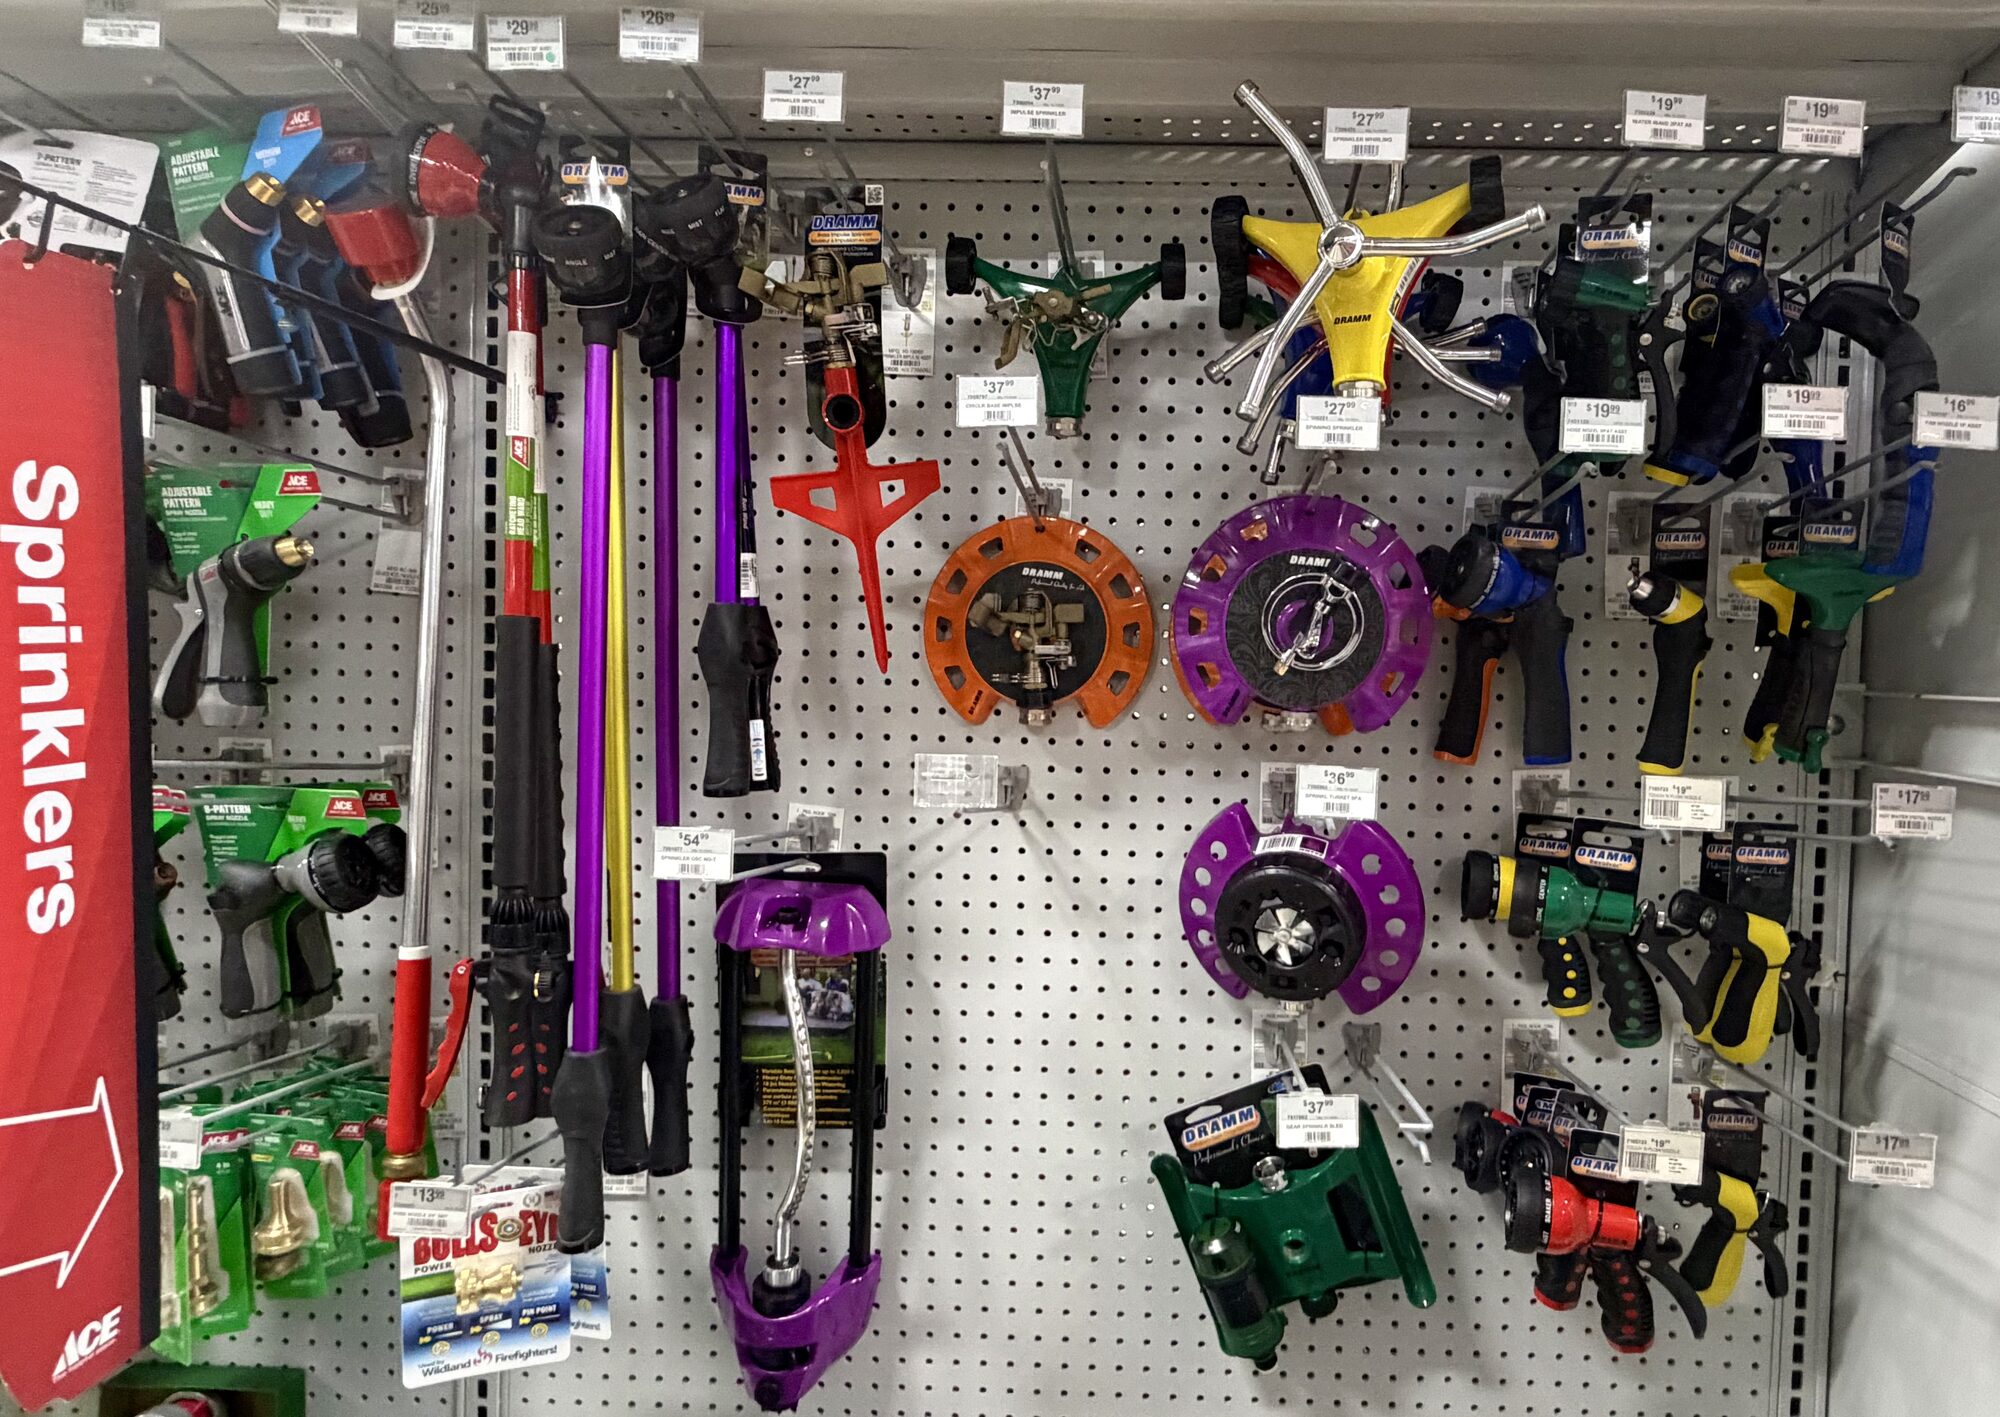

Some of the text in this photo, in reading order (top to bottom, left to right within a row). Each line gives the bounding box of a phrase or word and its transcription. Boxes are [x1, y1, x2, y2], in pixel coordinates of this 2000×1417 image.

[291, 110, 311, 126] ACE
[1036, 109, 1066, 117] SPRINKLER
[171, 146, 220, 167] ADJUSTABLE
[173, 161, 209, 178] PATTERN
[725, 185, 761, 198] AMM
[811, 214, 879, 230] DRAMM
[1333, 314, 1372, 325] DRAMM
[1586, 403, 1620, 418] $1999
[514, 440, 523, 459] ACE
[287, 475, 309, 486] ACE
[162, 486, 213, 497] ADJUSTABLE
[163, 497, 201, 509] PATTERN
[1504, 527, 1555, 540] DRAMM
[1657, 532, 1702, 543] DRAMM
[1806, 525, 1854, 537] DRAMM
[1768, 541, 1798, 552] DRA
[1022, 567, 1064, 580] DRAMM
[0, 459, 86, 935] Sprinklers
[368, 792, 388, 803] ACE
[333, 800, 353, 811] ACE
[1520, 838, 1568, 851] DRAMM
[1708, 844, 1732, 854] DRA
[1577, 847, 1633, 864] DRAMM
[1738, 847, 1788, 858] DRAMM
[1538, 879, 1547, 900] CENTER
[1530, 1111, 1551, 1123] DRA
[1555, 1116, 1574, 1129] DRA
[1709, 1114, 1755, 1124] DRAMM
[1185, 1107, 1254, 1143] DRAMM
[207, 1135, 229, 1146] ACE
[298, 1143, 314, 1153] ACE
[1573, 1158, 1616, 1172] DRAM
[413, 1211, 498, 1266] BULLS
[528, 1242, 558, 1254] NOZZ
[414, 1261, 452, 1275] POWER
[522, 1304, 557, 1317] PIN POINT
[479, 1313, 503, 1324] SPRAY
[426, 1322, 454, 1334] POWER
[52, 1305, 123, 1383] ACE
[421, 1345, 558, 1377] Wildland Firefighters!
